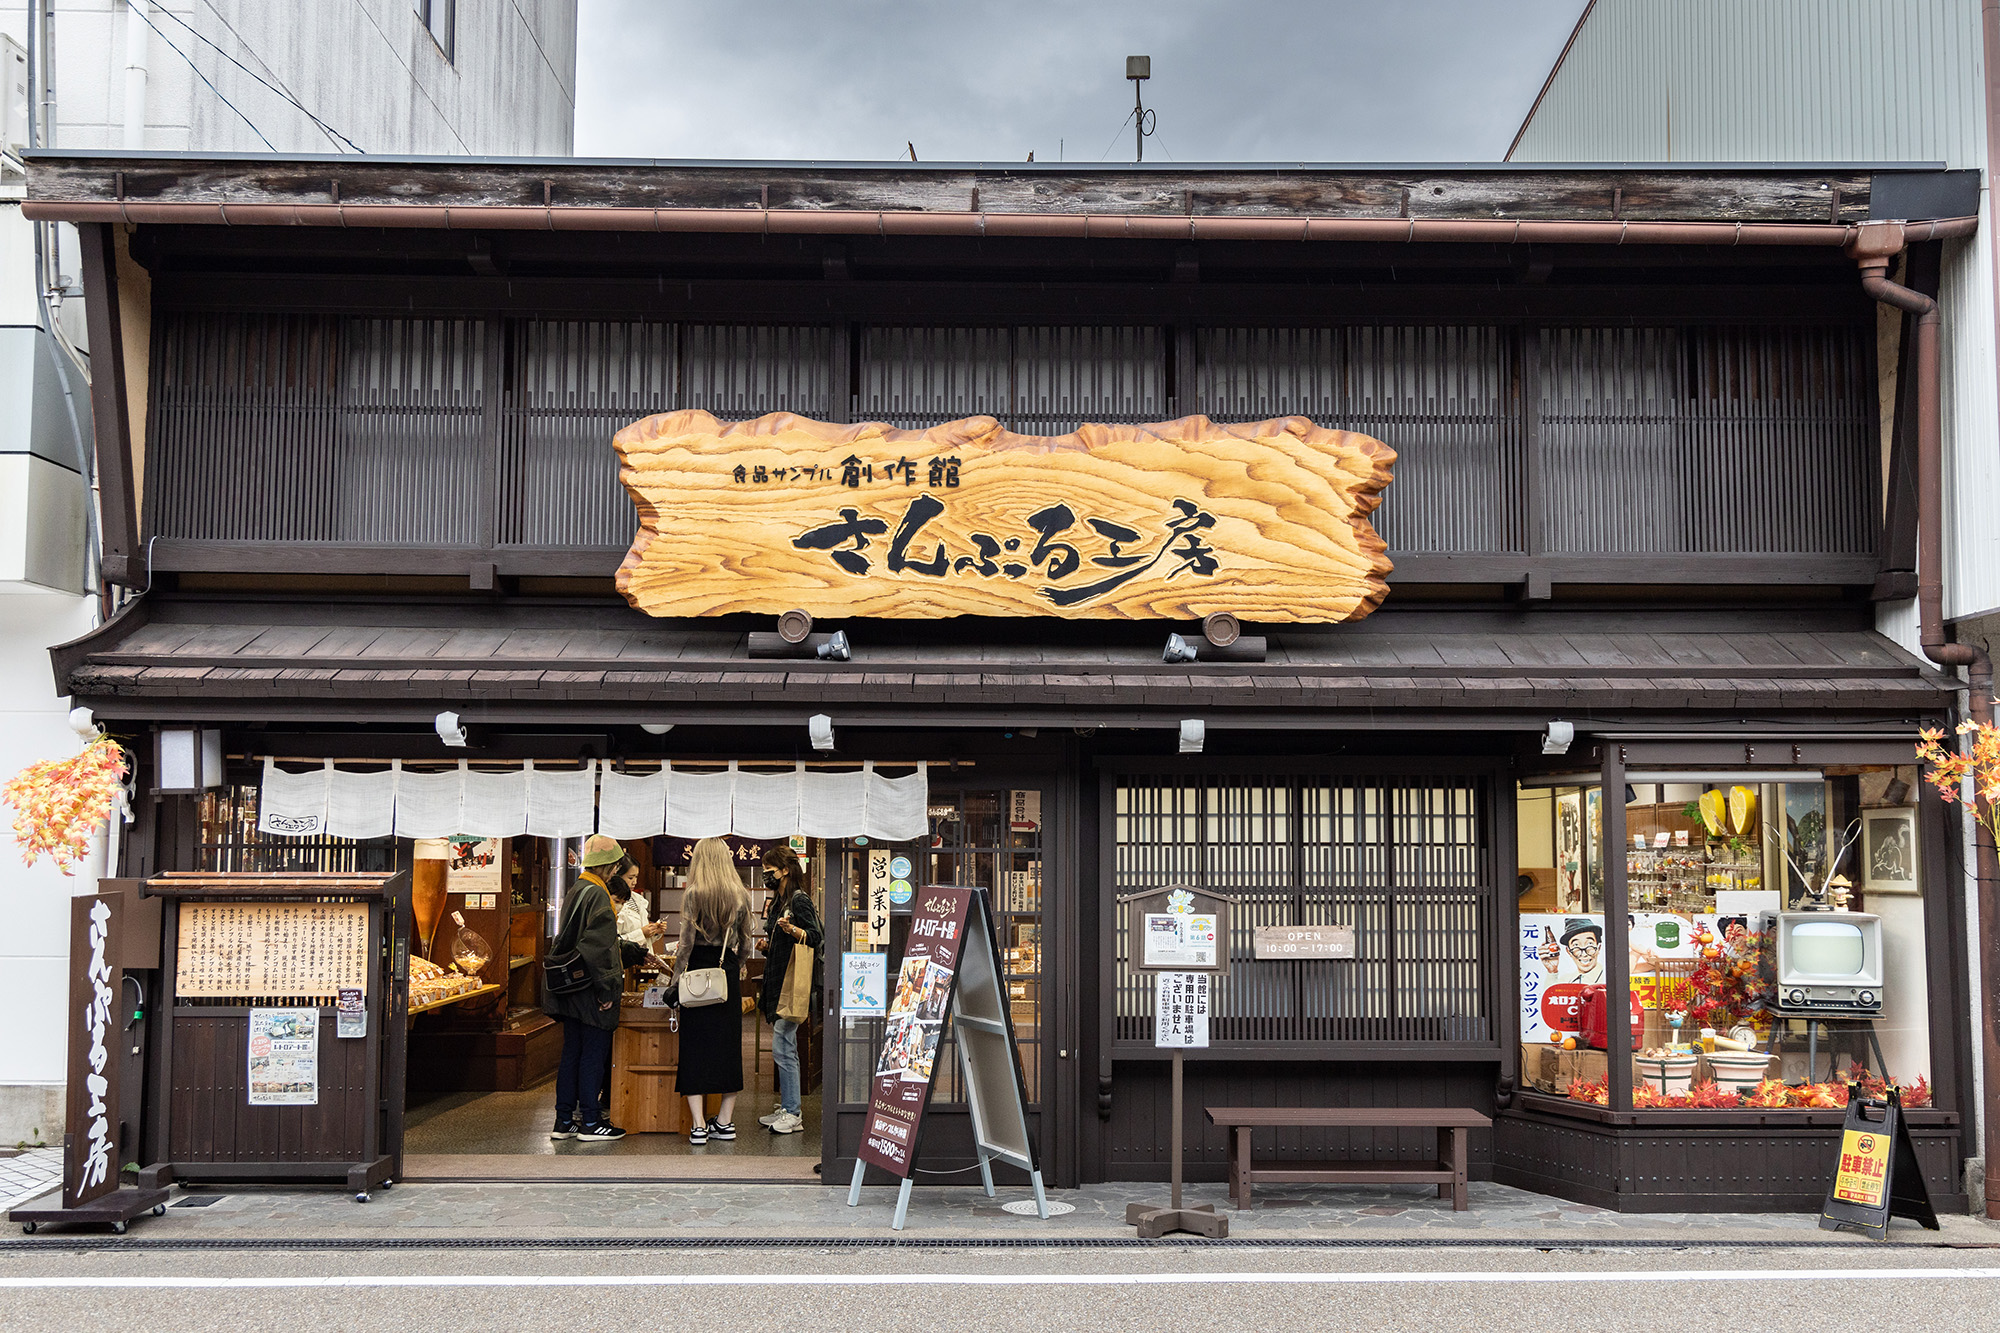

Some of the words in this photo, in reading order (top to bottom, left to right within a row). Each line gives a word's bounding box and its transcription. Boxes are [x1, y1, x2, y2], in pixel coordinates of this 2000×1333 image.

[791, 494, 1220, 607] さんぷる工房
[871, 857, 888, 937] 営業中
[1266, 944, 1297, 953] 10:00
[1312, 944, 1343, 952] 17:00
[1287, 932, 1321, 941] OPEN
[1172, 973, 1183, 1035] ございません
[1184, 974, 1195, 1045] 専用の駐車場は
[1197, 974, 1207, 1015] 当館には
[1567, 1005, 1579, 1016] C
[77, 899, 113, 1199] さんぷる工房
[1840, 1153, 1884, 1178] 駐車禁止
[1850, 1192, 1876, 1202] PARKING
